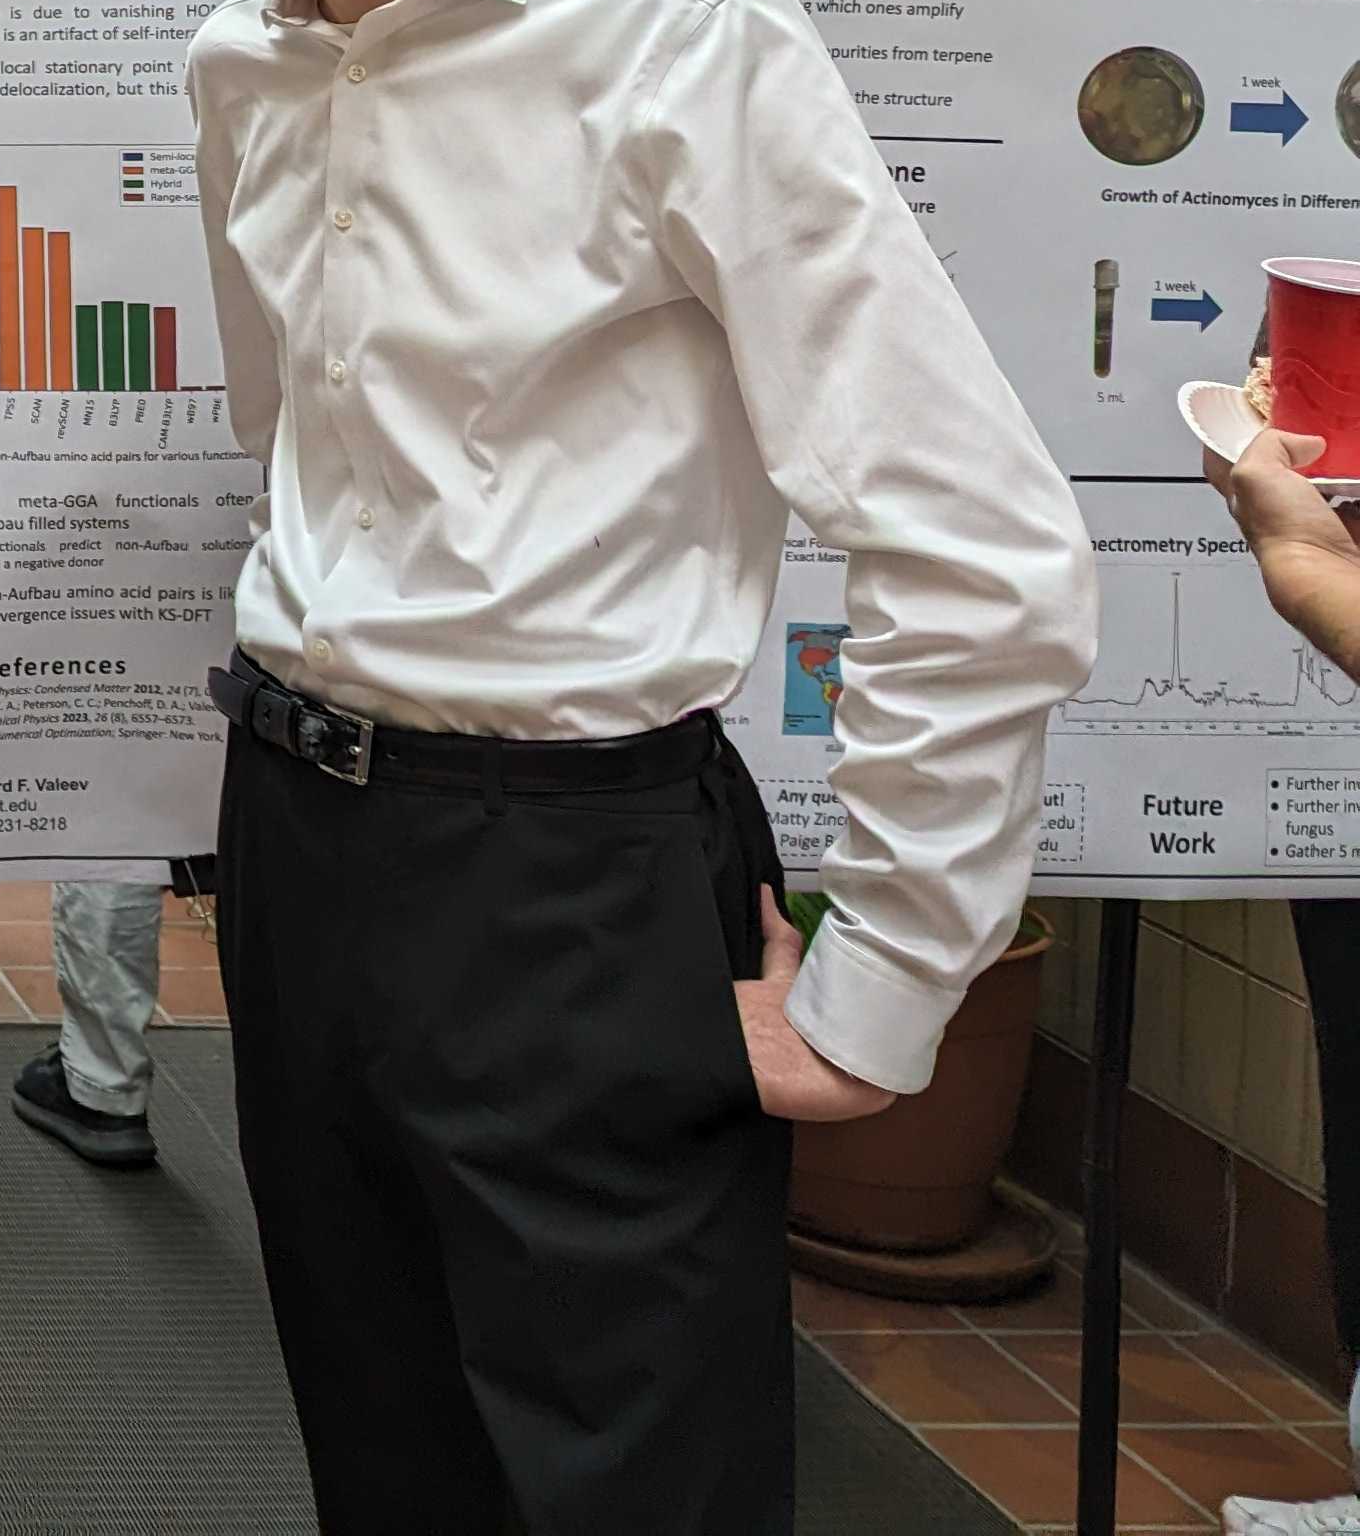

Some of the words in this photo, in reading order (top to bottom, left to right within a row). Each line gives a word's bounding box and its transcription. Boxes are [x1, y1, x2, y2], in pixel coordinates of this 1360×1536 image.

[11, 7, 21, 19] is
[33, 6, 63, 19] due
[74, 7, 89, 18] to
[101, 4, 174, 20] vanishing
[816, 0, 861, 13] which
[866, 4, 902, 15] ones
[907, 2, 964, 20] amplify
[4, 28, 15, 41] is
[20, 31, 37, 41] an
[43, 27, 98, 40] artifact
[103, 26, 119, 40] of
[1, 61, 35, 74] local
[45, 61, 123, 78] stationary
[133, 60, 174, 76] point
[0, 82, 110, 97] delocalization,
[117, 81, 143, 95] but
[149, 81, 177, 95] this
[1242, 76, 1247, 88] 1
[1251, 77, 1281, 88] week
[855, 90, 879, 104] the
[884, 93, 952, 106] structure
[1155, 281, 1161, 291] 1
[1165, 281, 1196, 292] week
[18, 779, 30, 792] F.
[35, 778, 88, 791] Valeev
[1287, 776, 1340, 791] Further
[1144, 795, 1223, 816] Future
[1287, 799, 1340, 813] Further
[1286, 821, 1334, 839] fungus
[1150, 832, 1215, 853] Work
